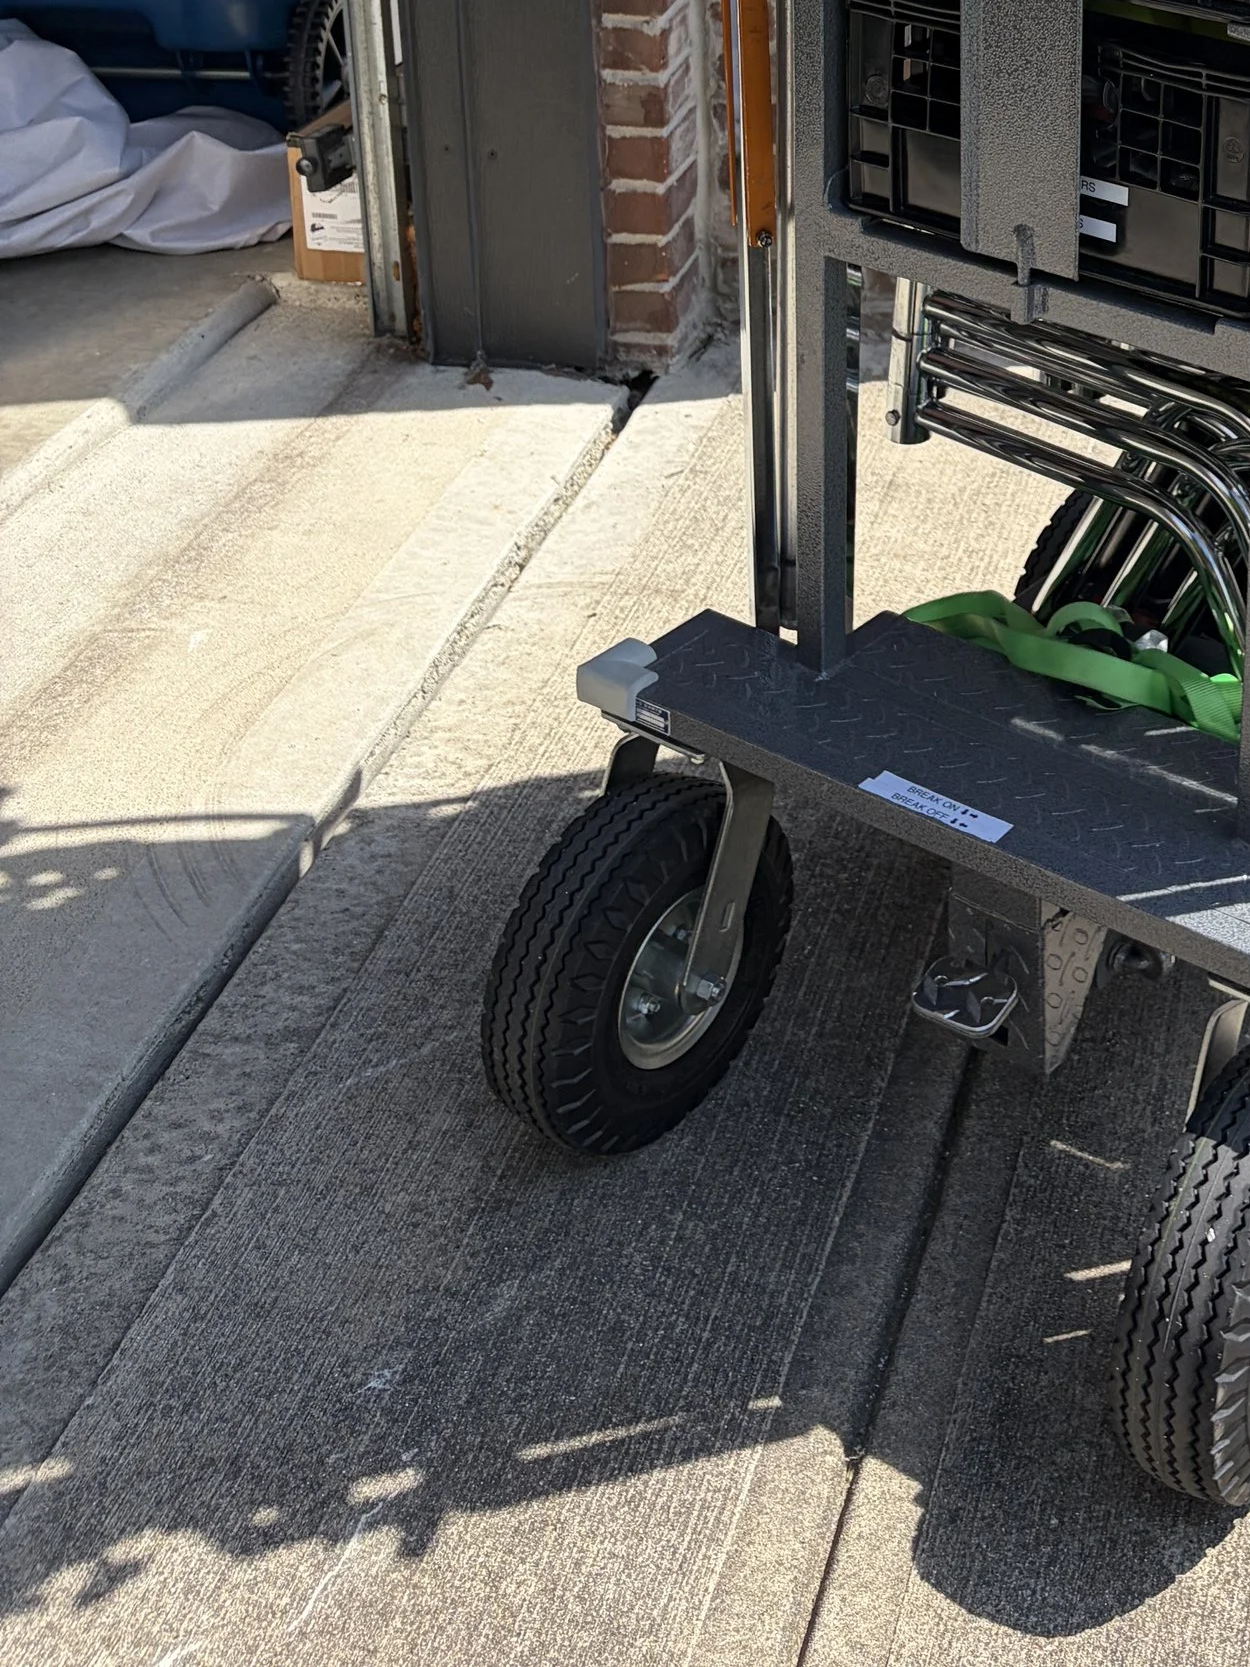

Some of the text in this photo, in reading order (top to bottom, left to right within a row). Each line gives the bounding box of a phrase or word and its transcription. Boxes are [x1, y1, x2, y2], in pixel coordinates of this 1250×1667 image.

[891, 793, 950, 820] BREAK OFF
[907, 785, 961, 812] BREAK ON
